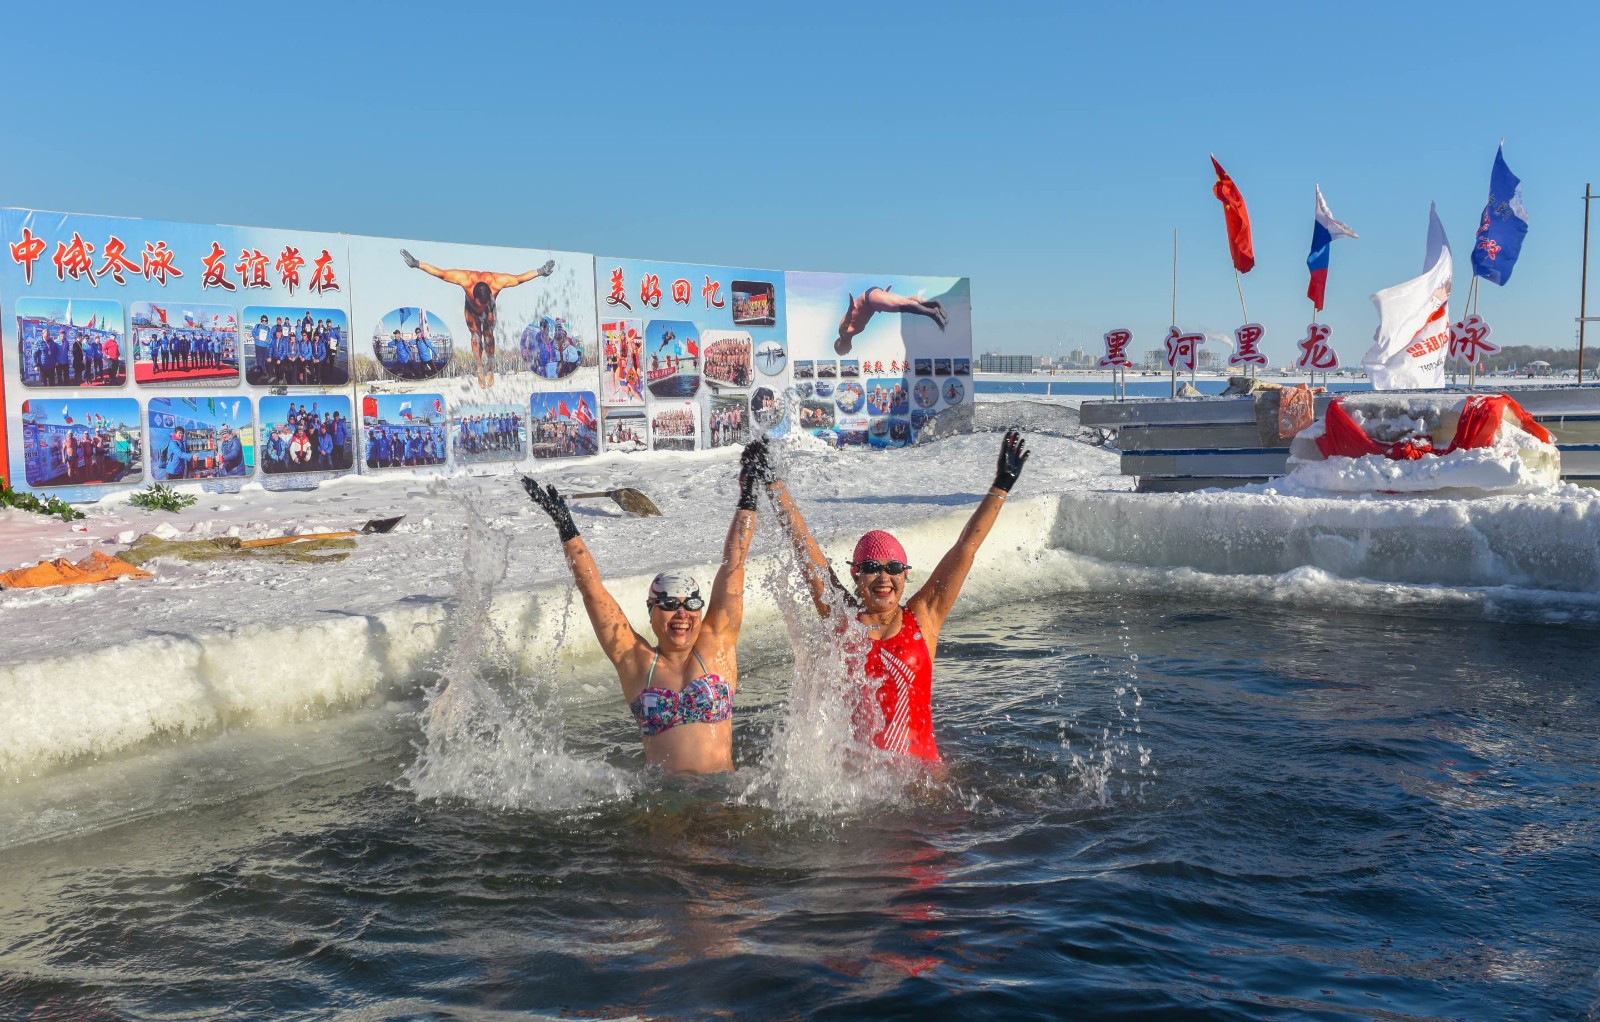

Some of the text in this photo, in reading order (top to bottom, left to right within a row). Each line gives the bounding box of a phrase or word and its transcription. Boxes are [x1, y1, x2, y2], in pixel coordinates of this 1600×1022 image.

[10, 228, 341, 296] 中俄冬泳 友谊常在
[606, 266, 725, 312] 美好回忆
